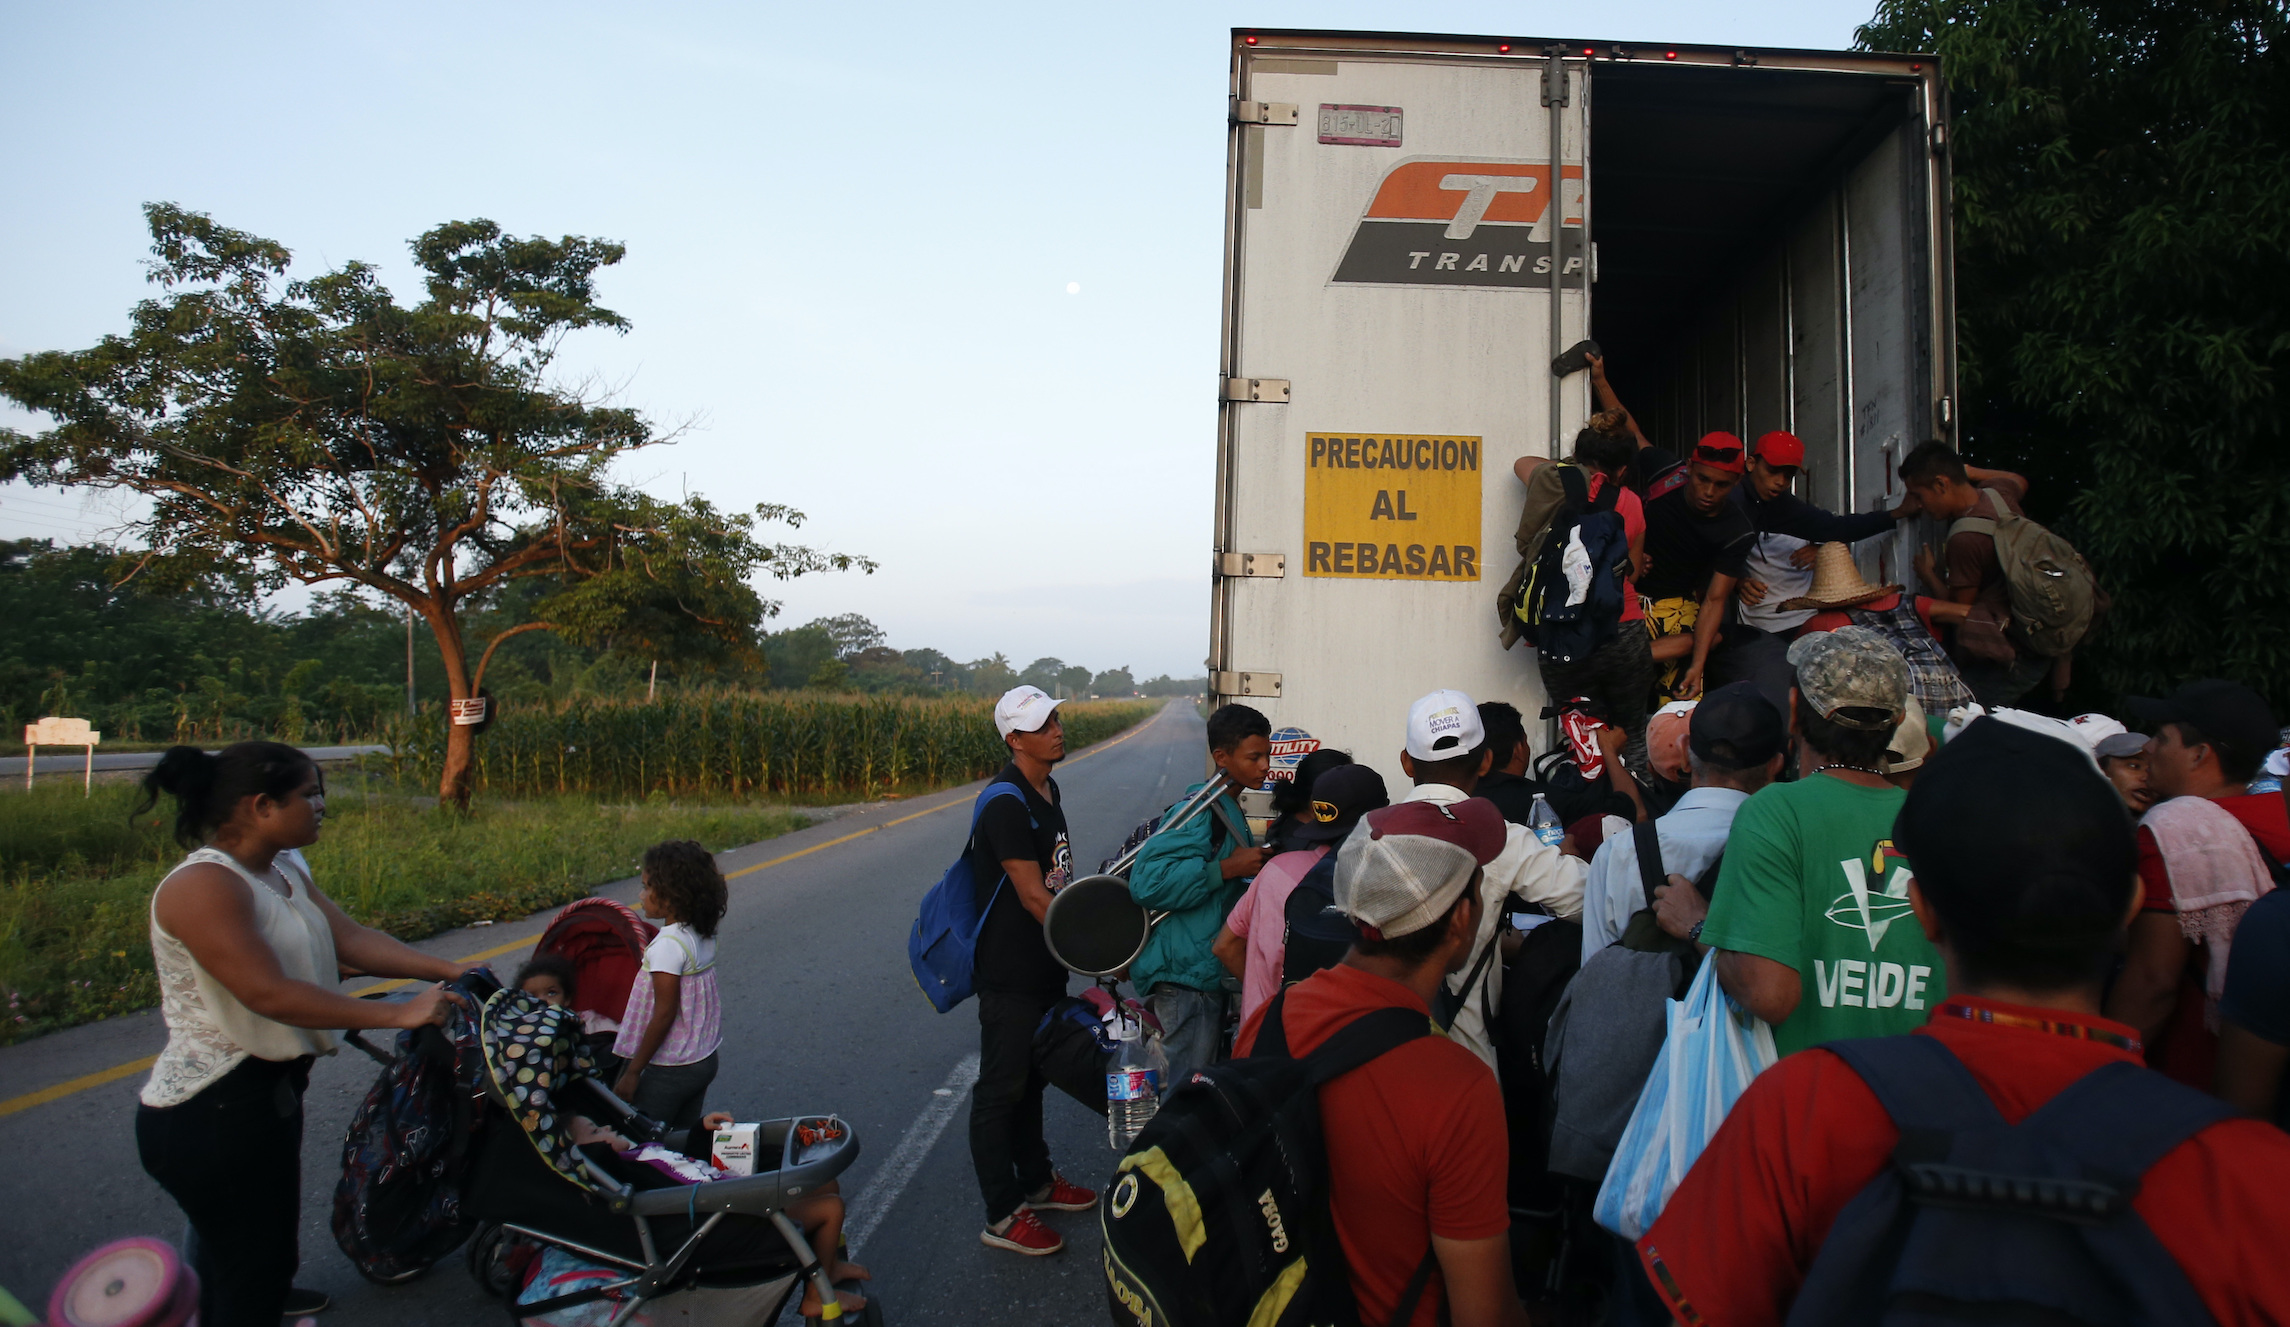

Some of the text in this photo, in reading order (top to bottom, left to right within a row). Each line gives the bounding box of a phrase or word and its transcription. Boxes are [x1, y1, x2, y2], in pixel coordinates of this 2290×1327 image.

[1311, 437, 1478, 471] PRECAUCION
[1370, 490, 1417, 520] AL
[1309, 541, 1477, 576] REBASAR
[1431, 722, 1461, 734] CHIAPAS
[1258, 1188, 1289, 1254] GAOBA
